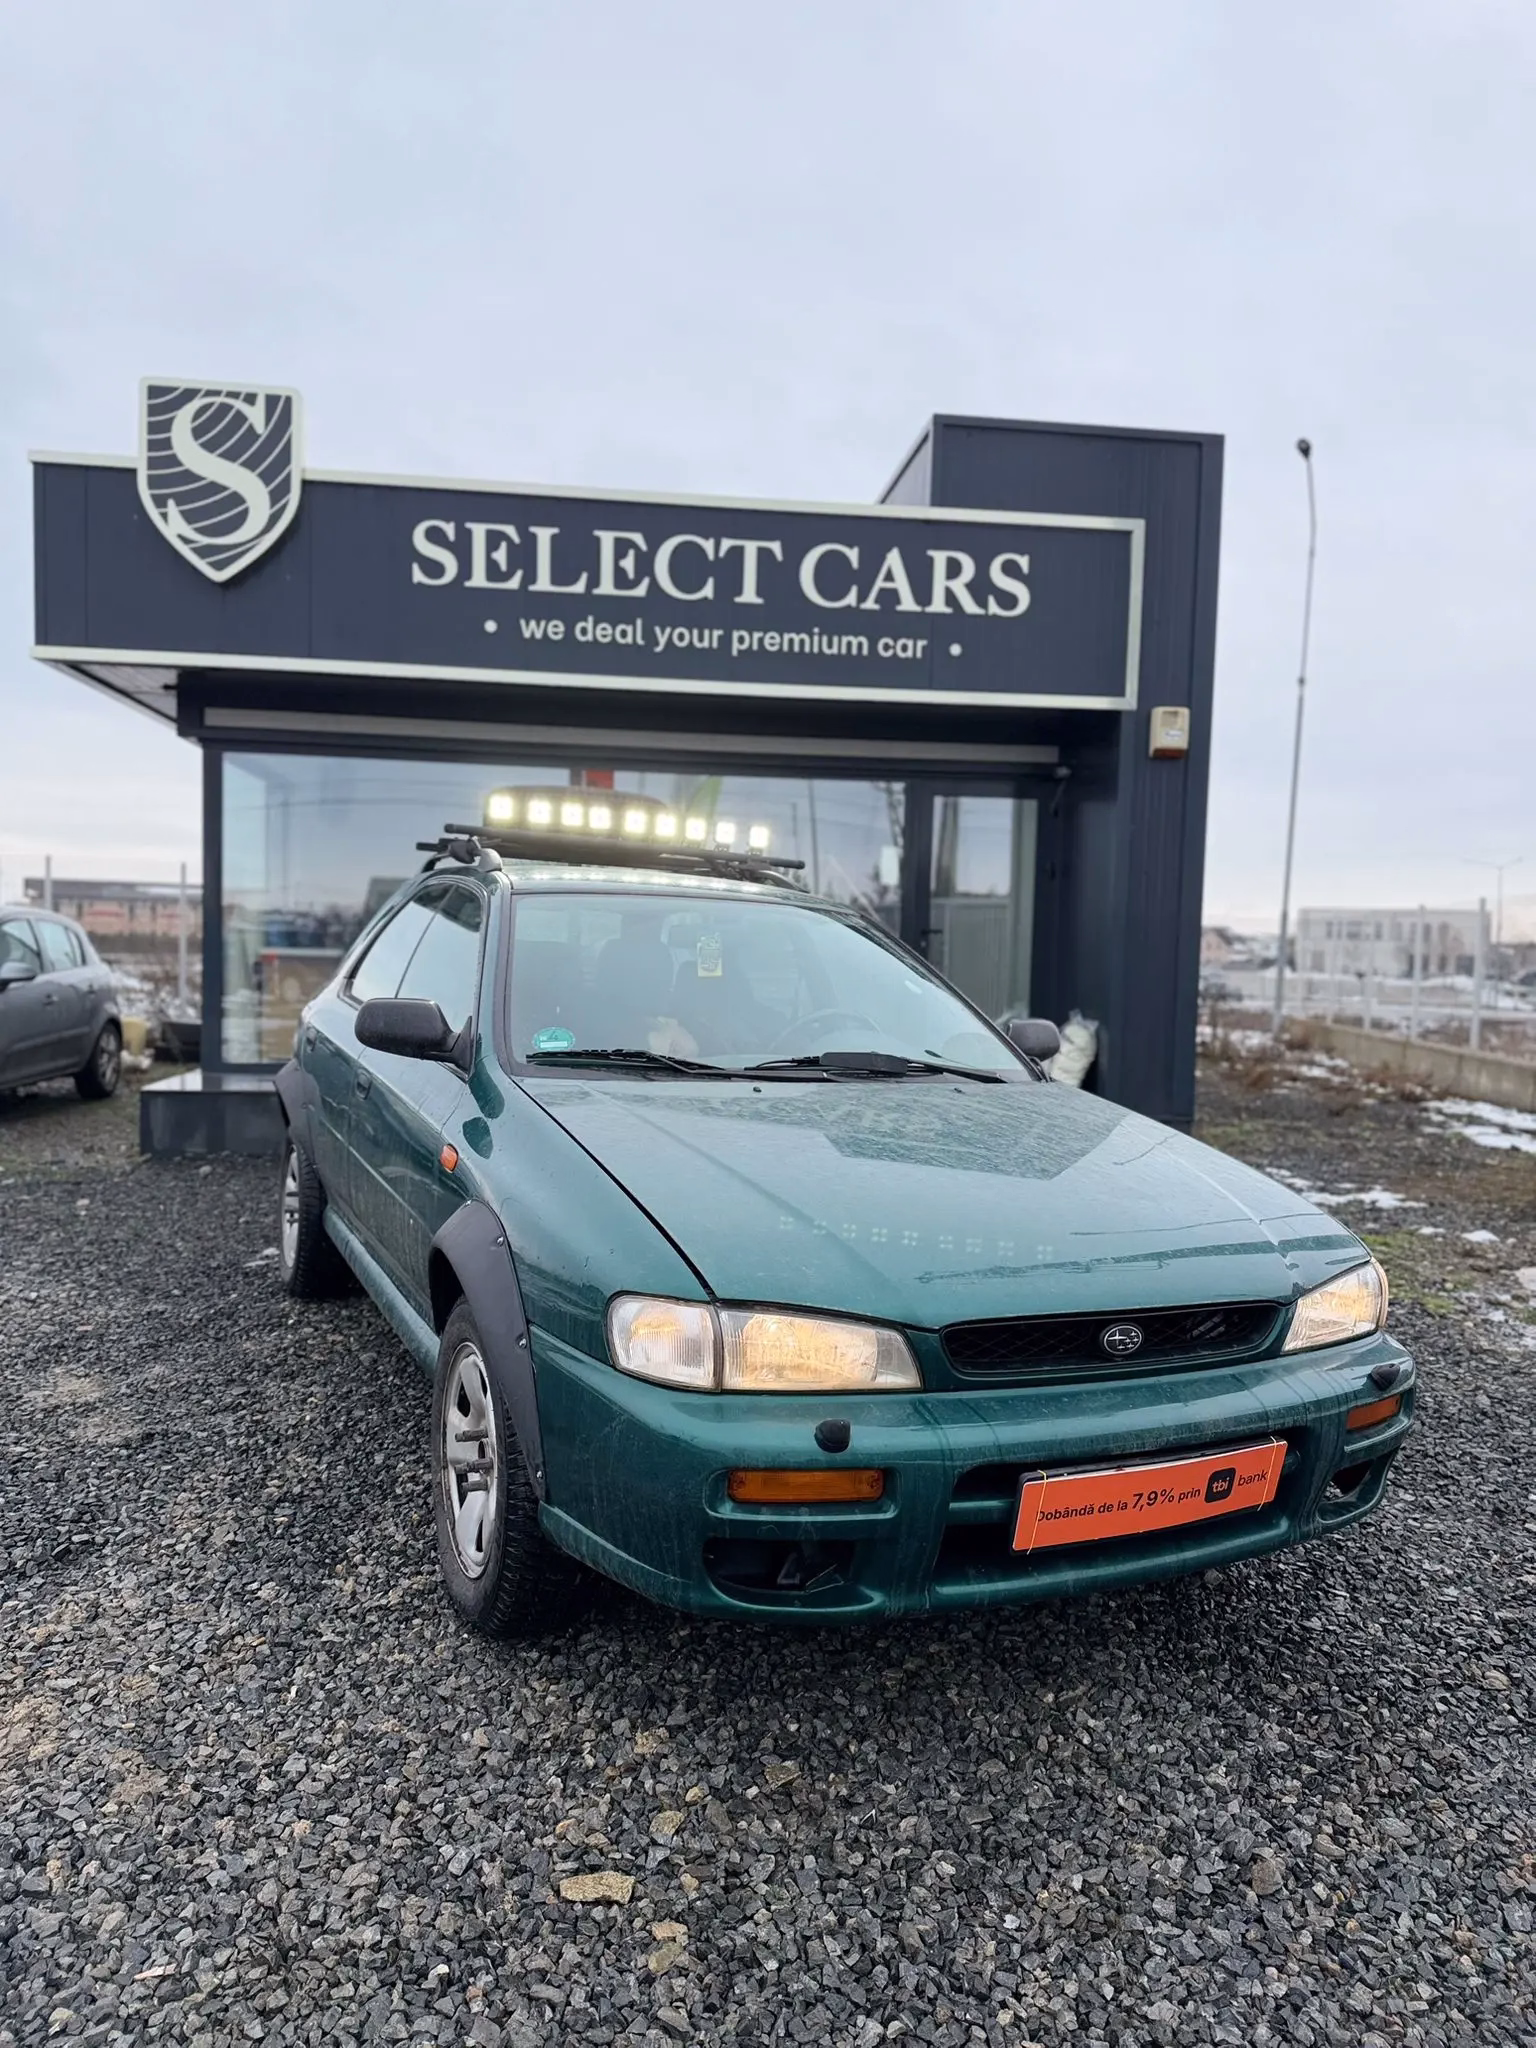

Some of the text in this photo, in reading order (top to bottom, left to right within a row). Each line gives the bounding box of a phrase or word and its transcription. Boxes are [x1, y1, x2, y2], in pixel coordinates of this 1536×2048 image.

[166, 392, 271, 546] S
[411, 519, 1031, 618] SELECT CARS
[520, 615, 928, 659] we deal your premium car
[1036, 1470, 1268, 1522] Dobândă de la 7,9% prin tbi bank
